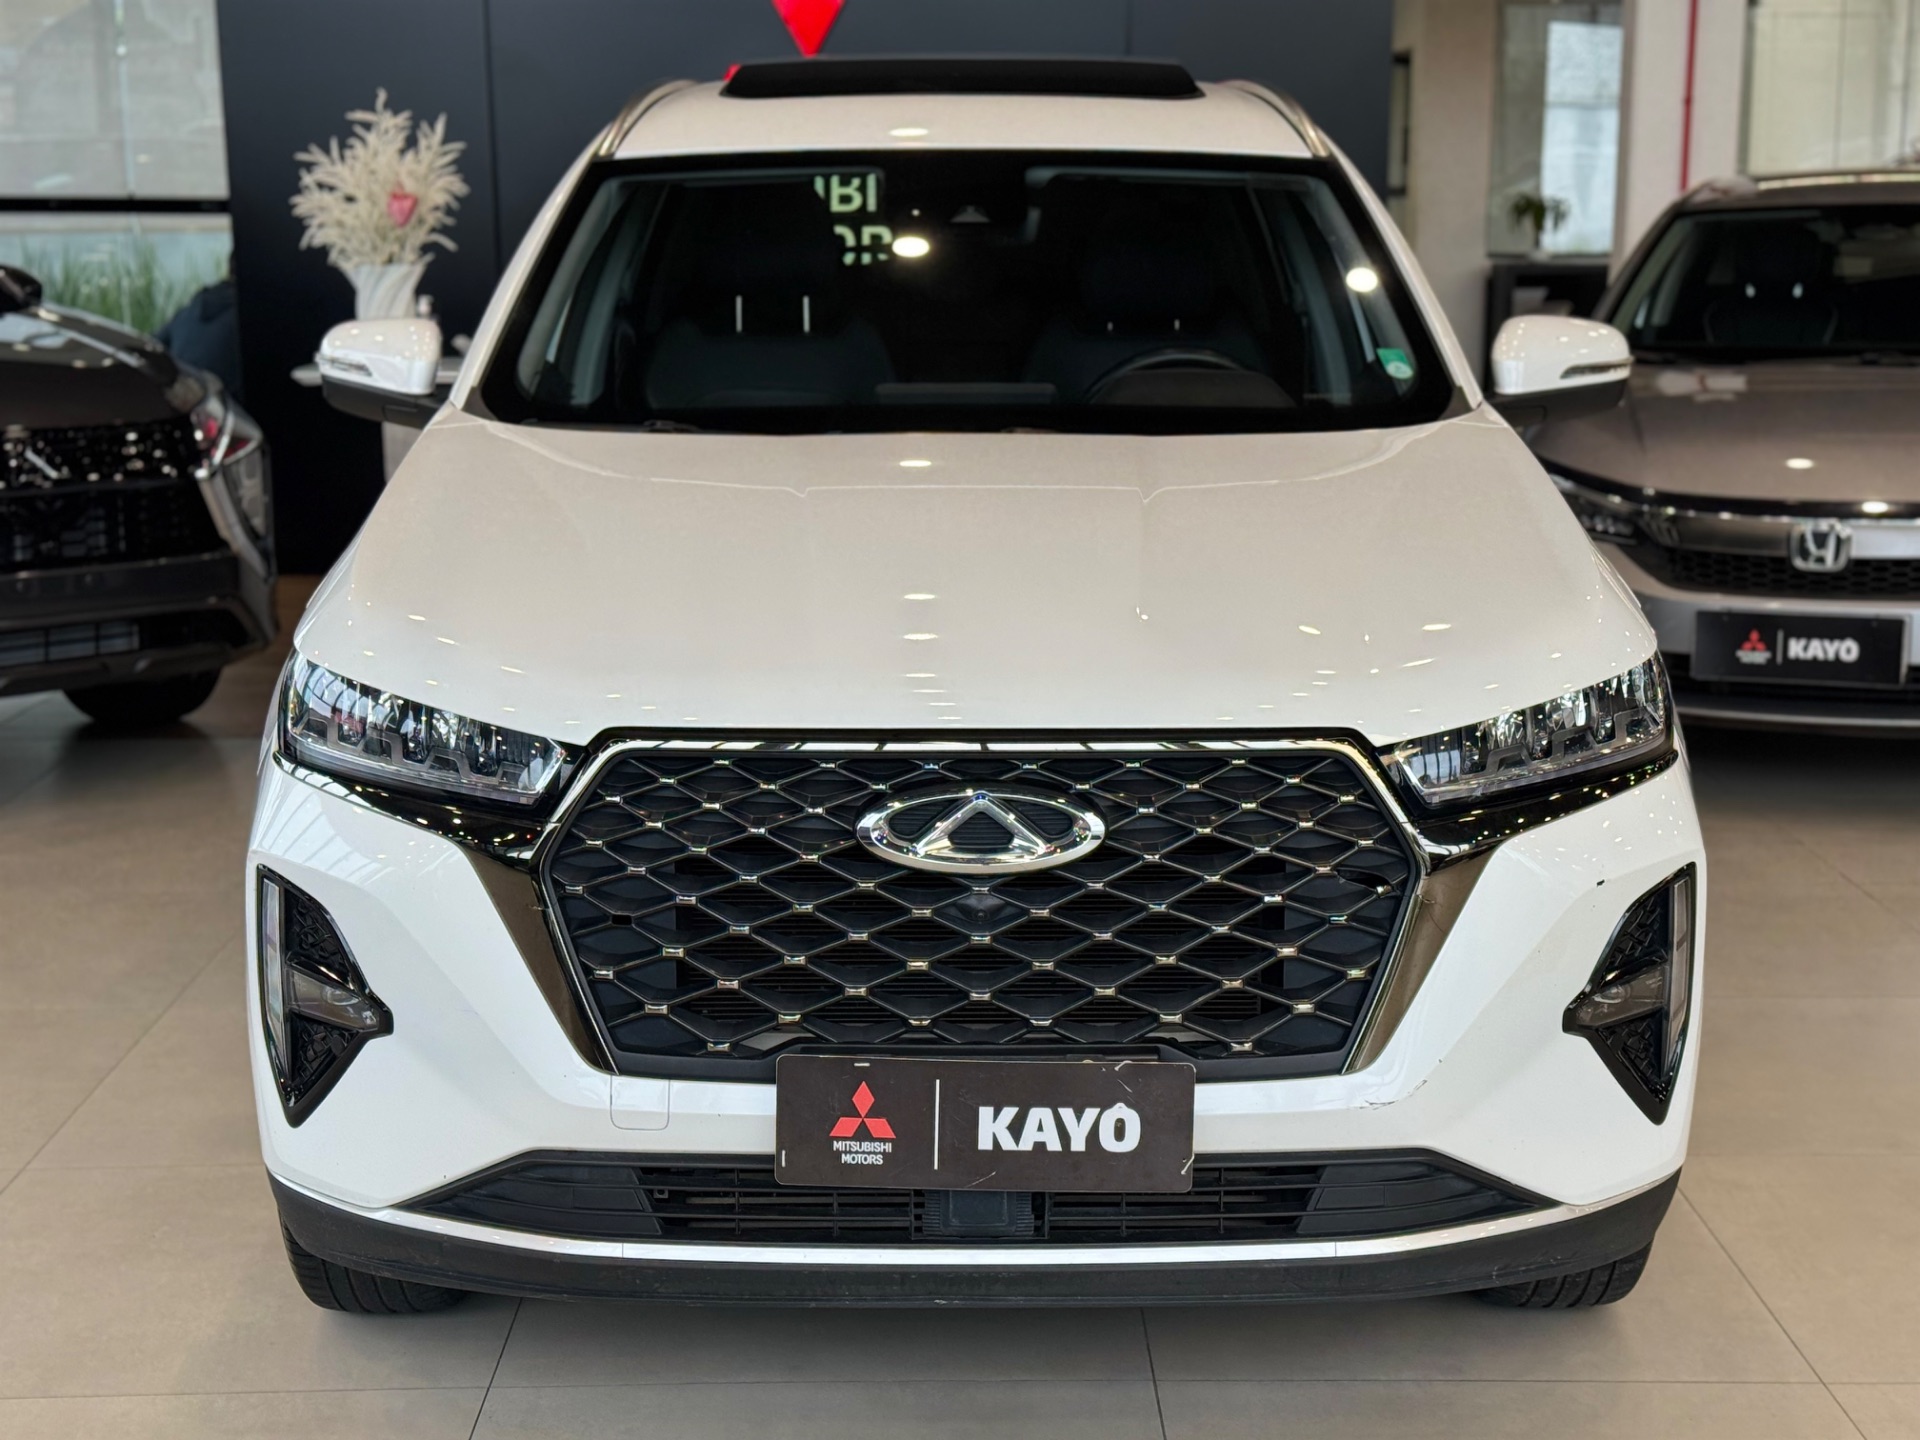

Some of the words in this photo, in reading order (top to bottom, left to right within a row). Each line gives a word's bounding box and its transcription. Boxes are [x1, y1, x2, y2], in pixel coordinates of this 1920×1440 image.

[977, 1102, 1142, 1153] KAYÔ
[832, 1140, 892, 1154] MITSUBISHI
[840, 1153, 884, 1165] MOTORS
